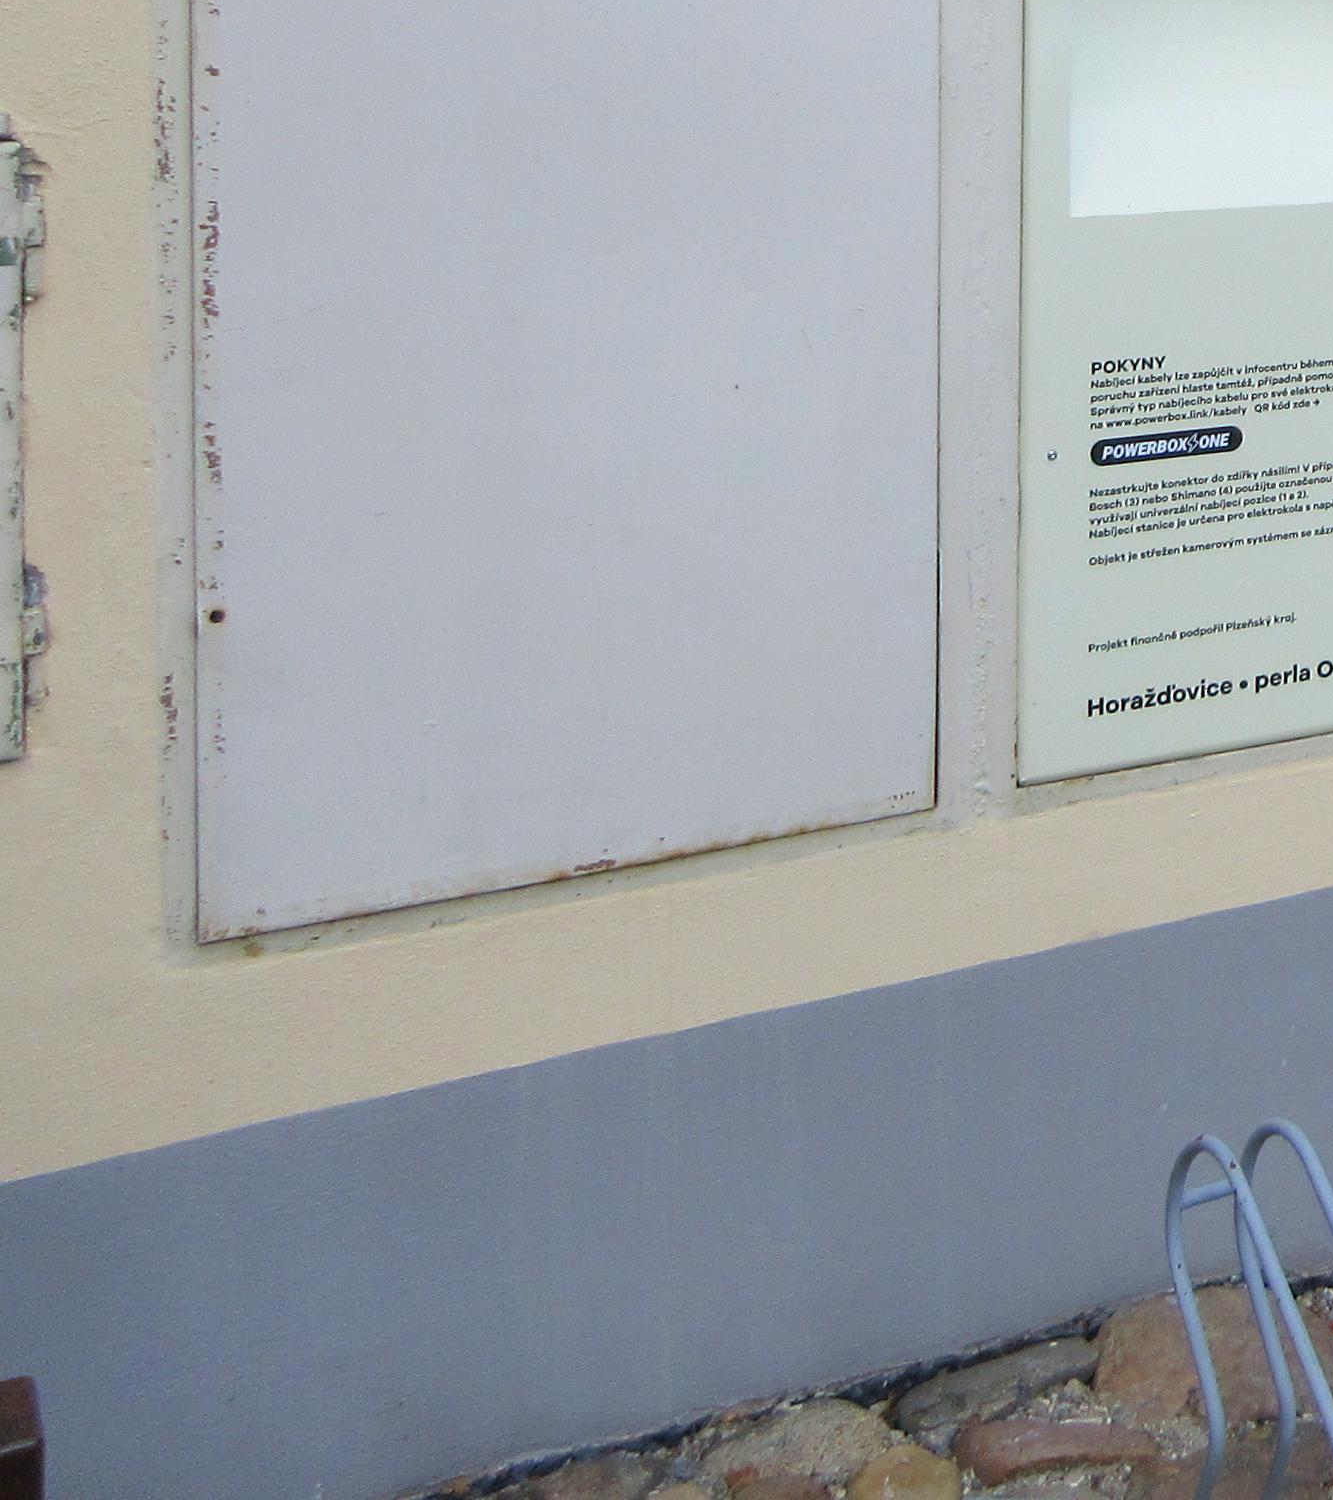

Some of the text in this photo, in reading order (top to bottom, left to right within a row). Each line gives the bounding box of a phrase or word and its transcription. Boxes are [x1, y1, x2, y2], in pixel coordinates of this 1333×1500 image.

[1090, 356, 1166, 375] POKYNY
[1090, 375, 1135, 389] Nabíjecí
[1138, 372, 1172, 386] kabely
[1175, 371, 1189, 381] lze
[1192, 365, 1234, 380] zapůjčit
[1300, 357, 1333, 369] během
[1090, 386, 1136, 403] poruchu
[1139, 384, 1180, 398] zařízení
[1182, 382, 1213, 394] hlaste
[1258, 372, 1303, 389] případně
[1090, 401, 1134, 416] Správný
[1138, 400, 1156, 414] typ
[1158, 394, 1212, 410] nabíjecího
[1215, 391, 1249, 404] kabelu
[1251, 390, 1268, 403] pro
[1271, 387, 1288, 398] své
[1090, 398, 1311, 430] na www.powerbox.link/kabely QR kód zde
[1101, 432, 1231, 461] POWERBOX ONE
[1089, 482, 1159, 498] Nezastrkujte
[1161, 475, 1209, 489] konektor
[1211, 473, 1224, 484] do
[1227, 469, 1258, 482] zdířky
[1303, 464, 1310, 472] V
[1089, 499, 1122, 512] Bosch
[1125, 497, 1139, 508] (3)
[1142, 493, 1168, 504] nebo
[1171, 489, 1216, 502] Shimano
[1235, 481, 1276, 495] použijte
[1279, 475, 1332, 489] označenou
[1089, 511, 1137, 526] využívají
[1139, 503, 1199, 518] univerzální
[1200, 497, 1241, 512] nabíjecí
[1243, 493, 1276, 507] pozice
[1089, 525, 1134, 540] Nabíjecí
[1136, 520, 1174, 533] stanice
[1177, 518, 1186, 529] je
[1189, 513, 1225, 526] určena
[1227, 511, 1245, 524] pro
[1247, 504, 1303, 519] elektrokola
[1089, 553, 1126, 567] Objekt
[1128, 550, 1138, 562] je
[1140, 545, 1180, 560] střežen
[1182, 536, 1244, 554] kamerovým
[1247, 531, 1298, 545] systémem
[1301, 530, 1311, 538] se
[1088, 637, 1128, 653] Projekt
[1130, 629, 1177, 646] finančně
[1180, 623, 1224, 640] podpořil
[1225, 614, 1272, 632] Plzeňský
[1087, 678, 1233, 717] Horažďovice
[1254, 663, 1311, 693] perla
